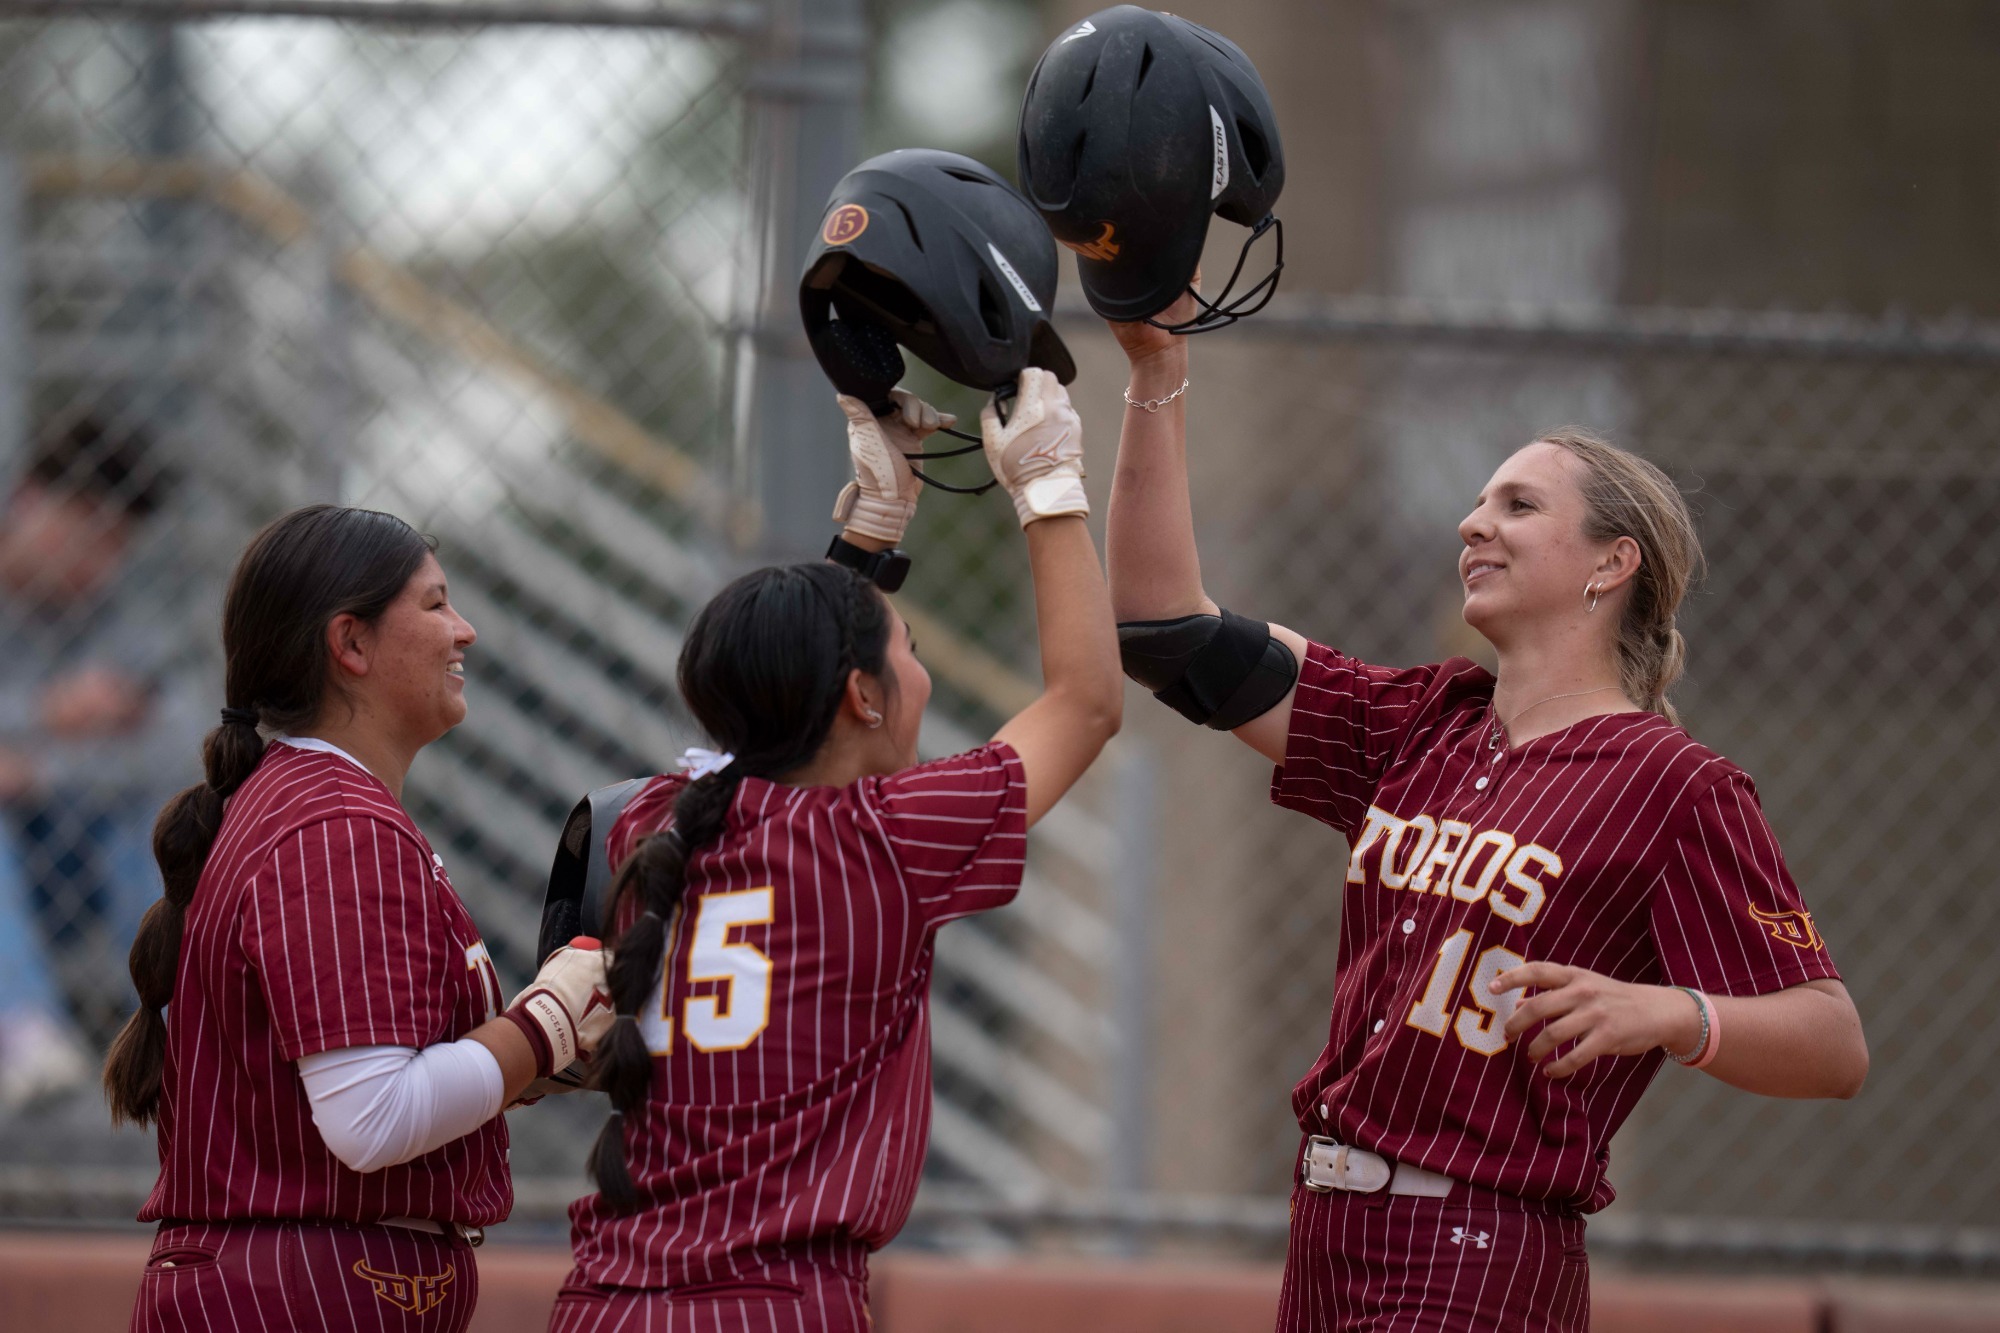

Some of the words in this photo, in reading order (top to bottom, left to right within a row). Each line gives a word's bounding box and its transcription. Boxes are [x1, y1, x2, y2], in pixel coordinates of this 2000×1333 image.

[1215, 125, 1224, 186] EASTON
[831, 211, 857, 237] 15
[1346, 803, 1564, 926] TOROS
[535, 999, 560, 1029] BRUCE
[1406, 927, 1528, 1057] 19
